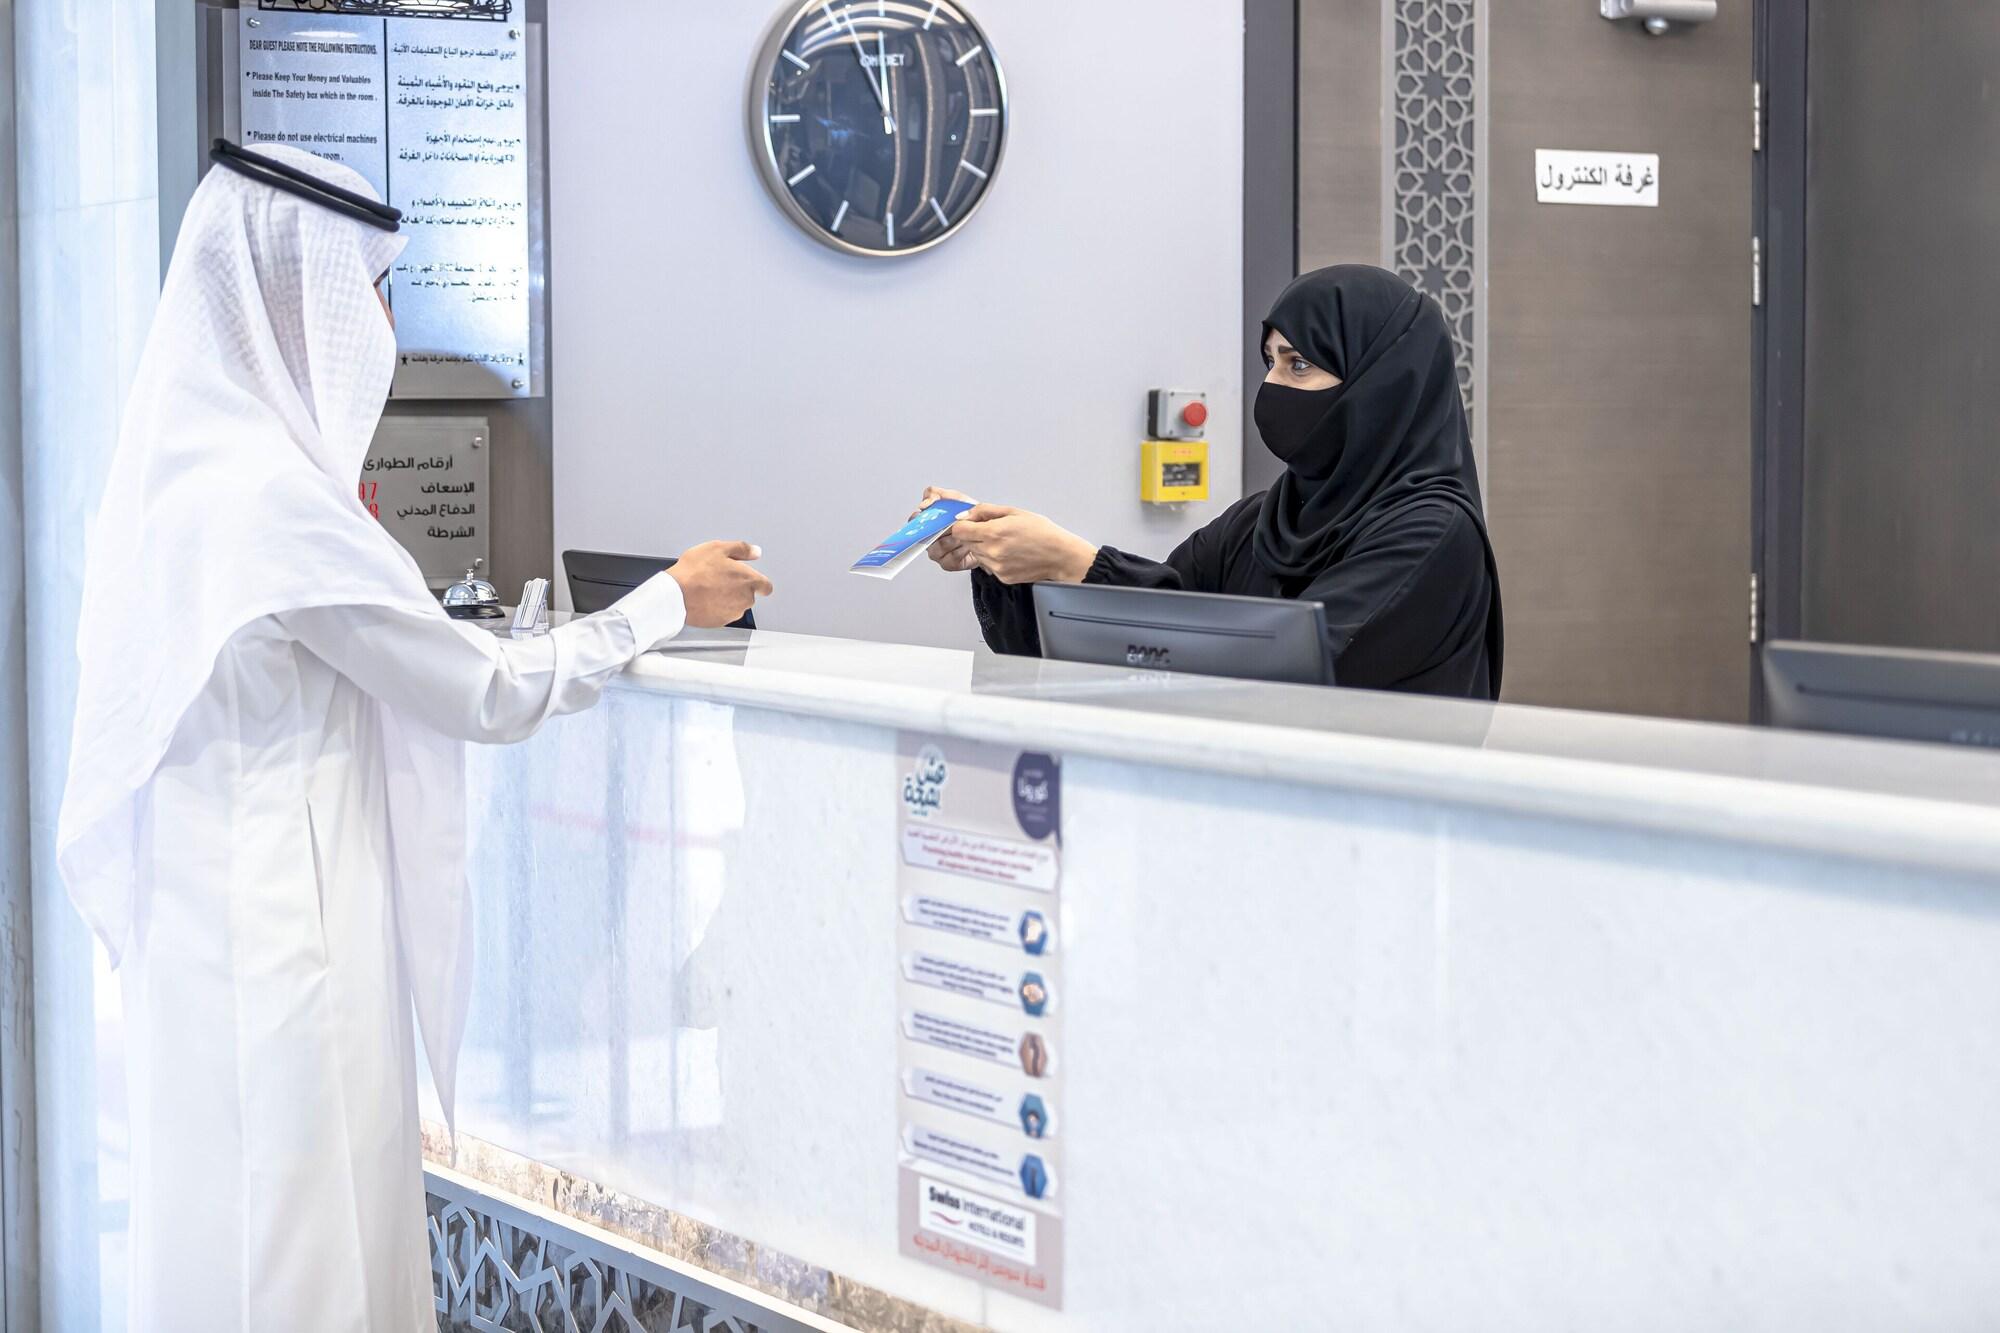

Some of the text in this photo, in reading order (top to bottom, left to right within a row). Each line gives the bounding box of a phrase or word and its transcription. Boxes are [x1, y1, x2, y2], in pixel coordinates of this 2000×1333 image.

[279, 41, 295, 51] PLEASE
[252, 72, 371, 84] Please Keep Your Money and Valuables
[272, 89, 284, 98] The
[286, 89, 305, 101] Safety
[307, 91, 318, 99] box
[320, 91, 338, 100] which
[339, 91, 345, 100] in
[347, 92, 357, 100] the
[253, 131, 377, 145] Please do not use electrical machines
[1541, 163, 1654, 194] غرفة الكنترول
[417, 454, 453, 471] أرقام
[396, 503, 475, 520] الدفاع المدني
[427, 525, 475, 540] الشرطة
[929, 1186, 961, 1209] Swiss
